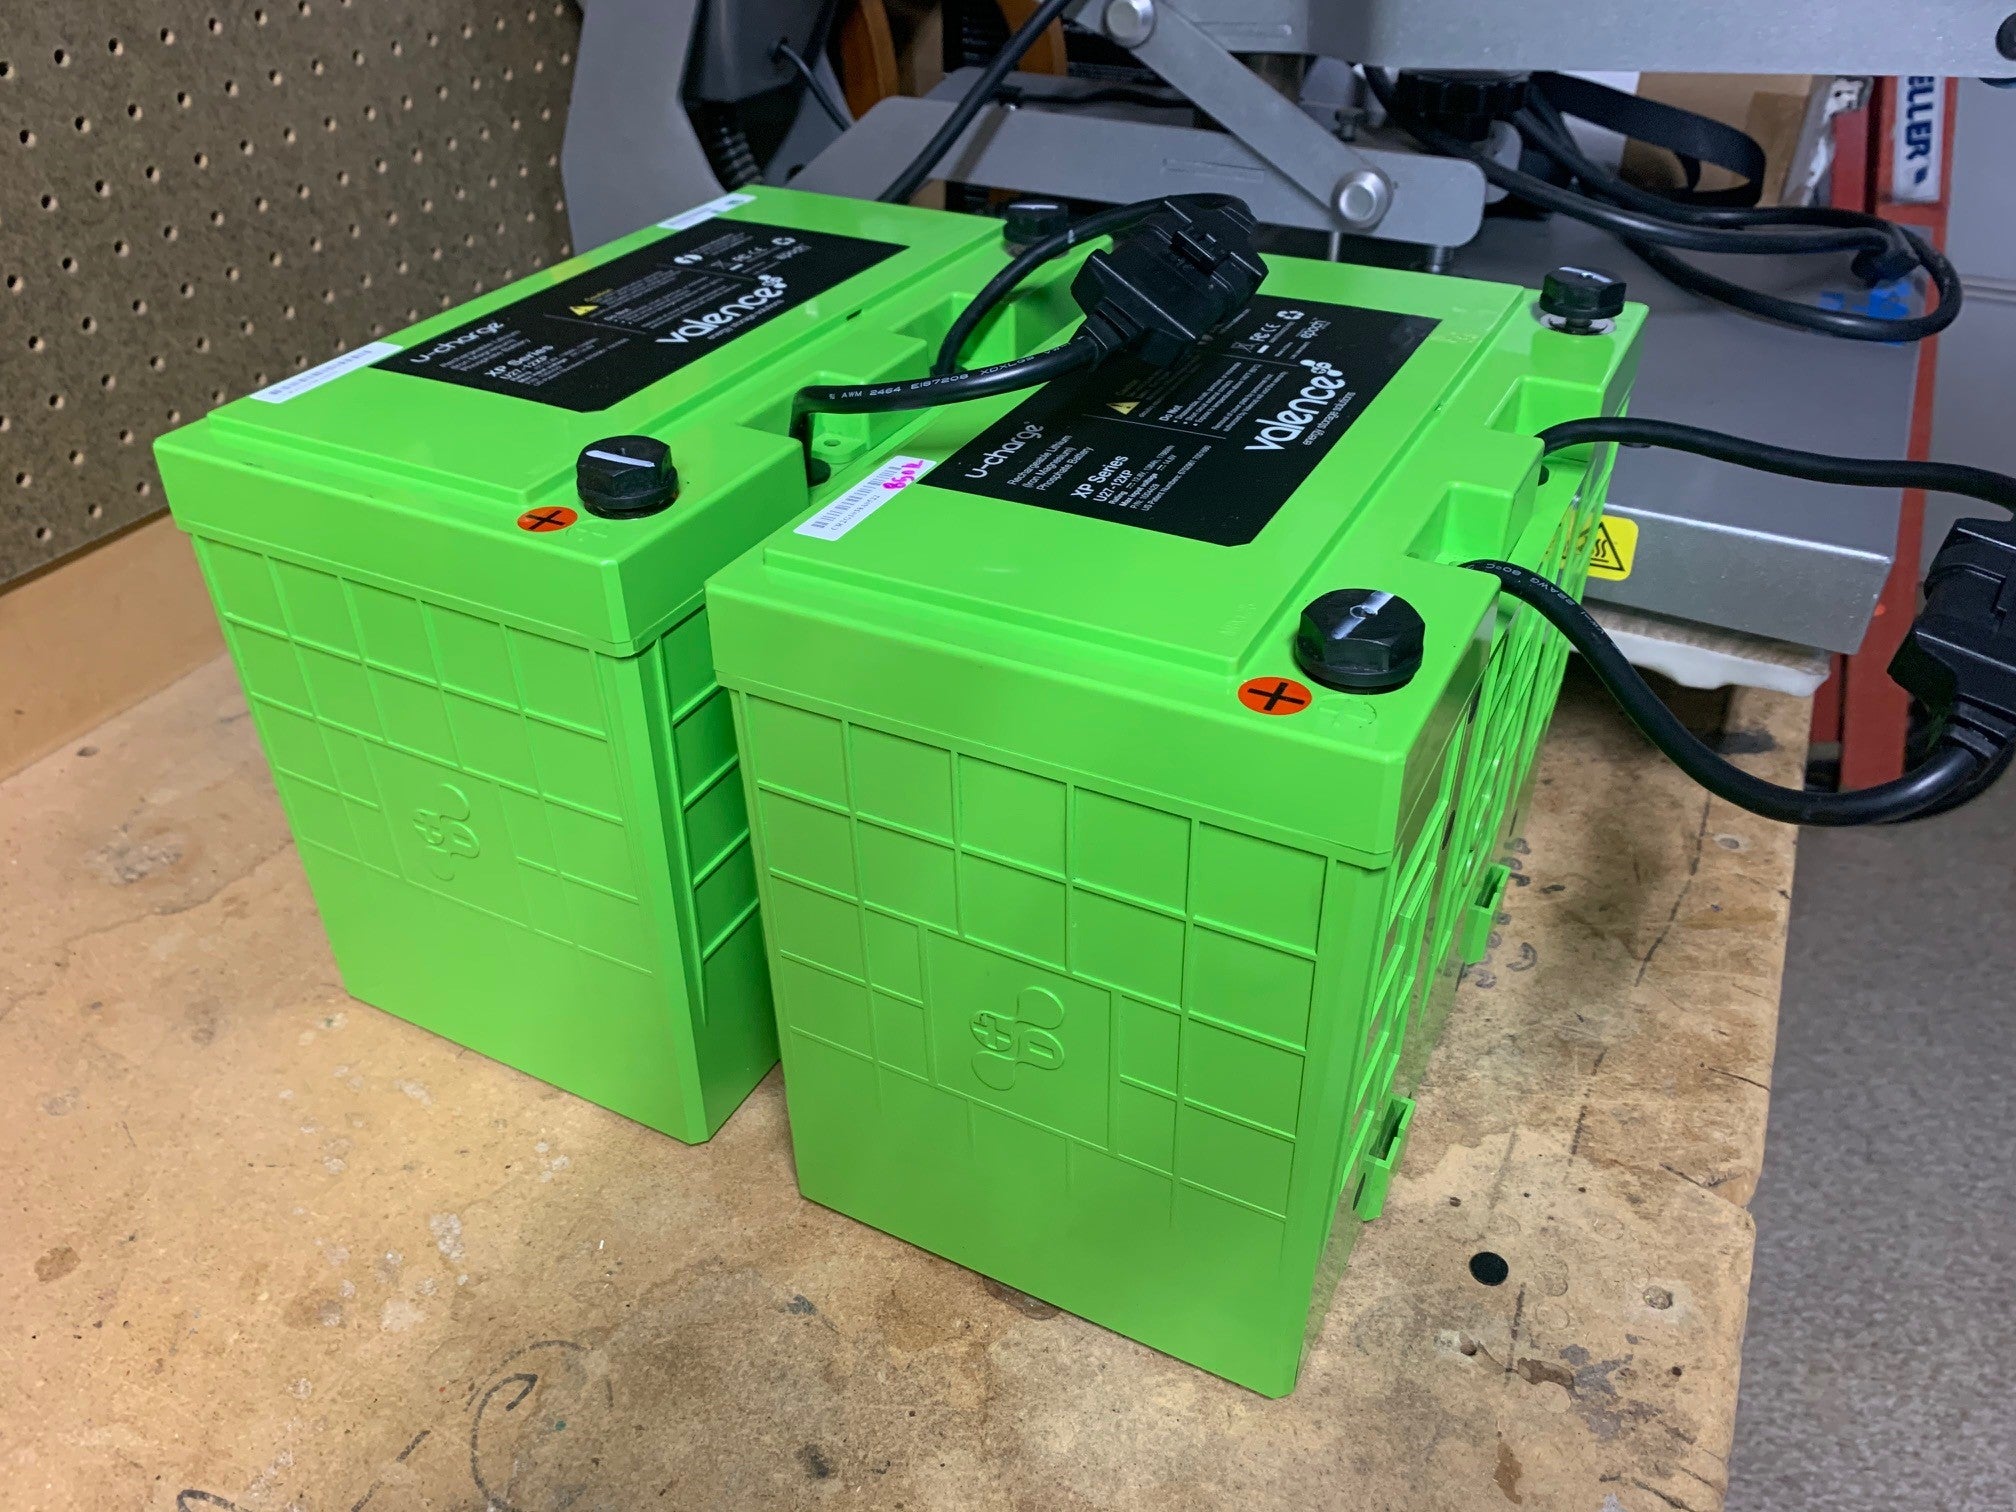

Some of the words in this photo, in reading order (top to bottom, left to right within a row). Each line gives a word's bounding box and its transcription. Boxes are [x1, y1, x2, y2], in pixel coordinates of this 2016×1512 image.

[657, 287, 783, 343] valence
[841, 390, 863, 398] AWM
[870, 386, 901, 396] 2464
[1166, 405, 1183, 414] Not
[1245, 376, 1345, 450] valence
[965, 424, 1043, 478] u-charge
[1070, 483, 1094, 498] XP
[1088, 456, 1128, 483] Series
[1093, 470, 1132, 502] U27-12XP
